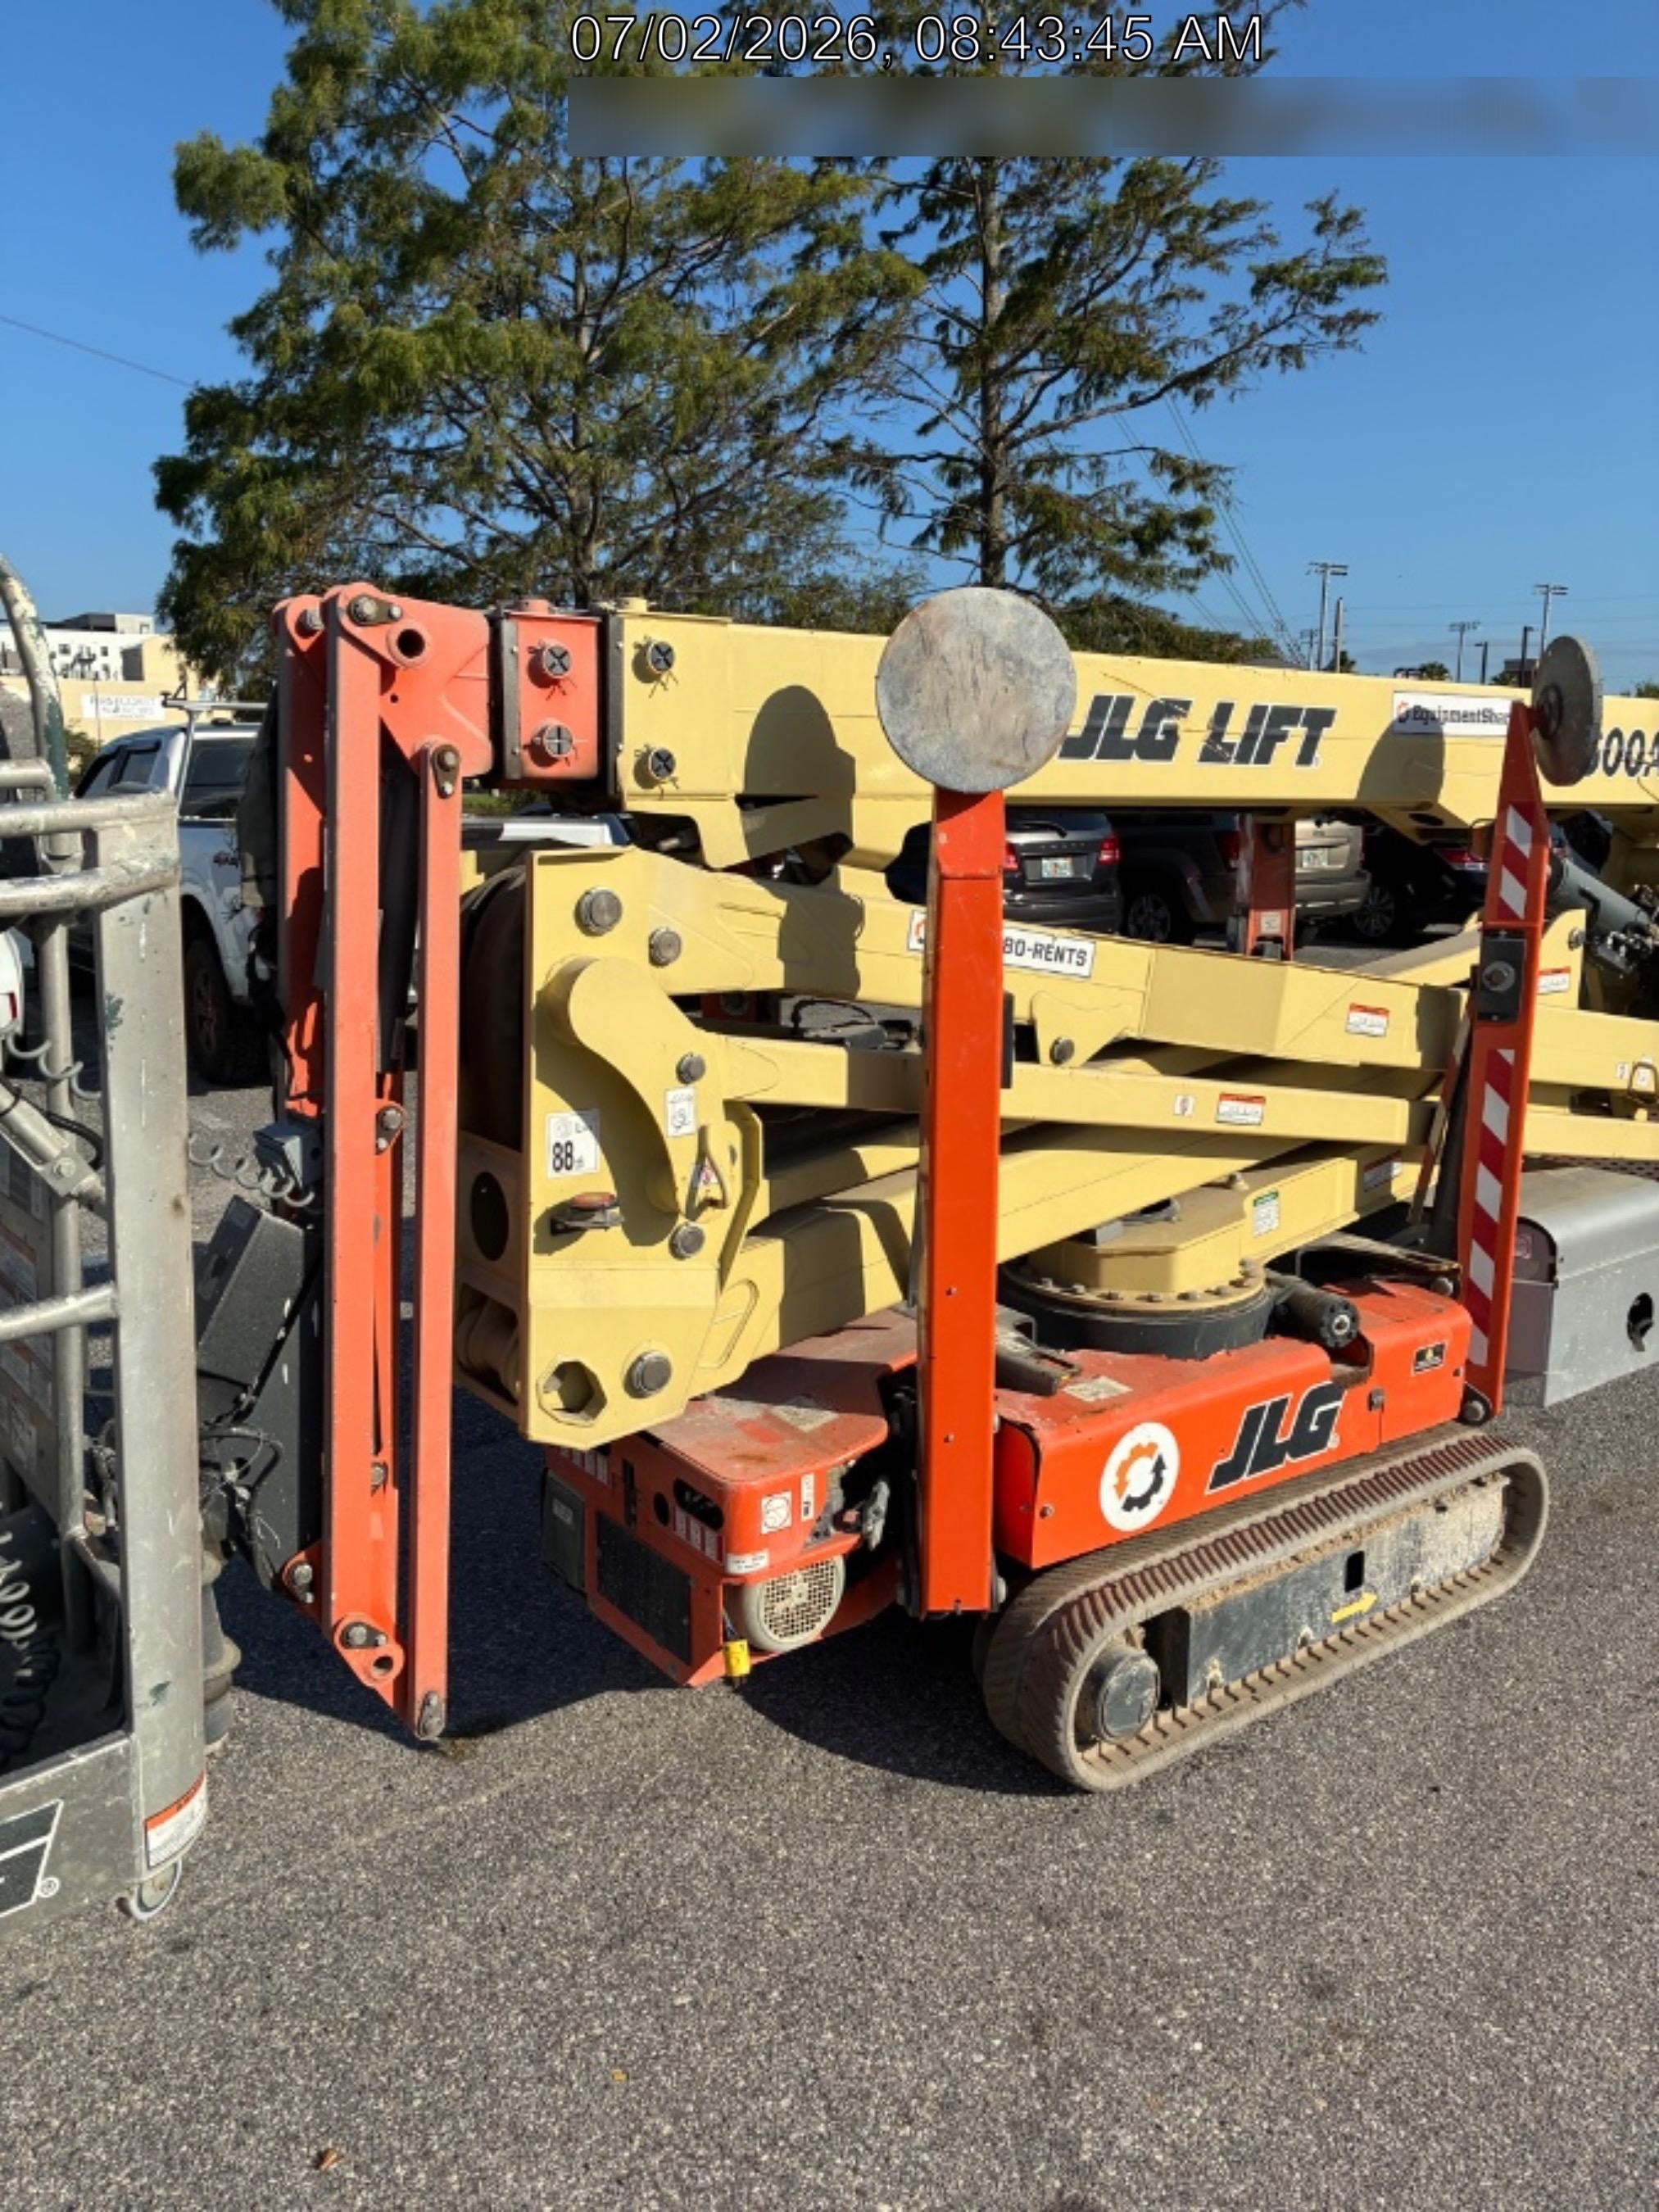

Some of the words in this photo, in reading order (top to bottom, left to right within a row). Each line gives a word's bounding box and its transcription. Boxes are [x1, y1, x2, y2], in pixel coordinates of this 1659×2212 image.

[1058, 694, 1193, 760] JLG
[1197, 701, 1338, 767] LIFT
[552, 1140, 573, 1172] 88
[1204, 1380, 1348, 1495] JLG
